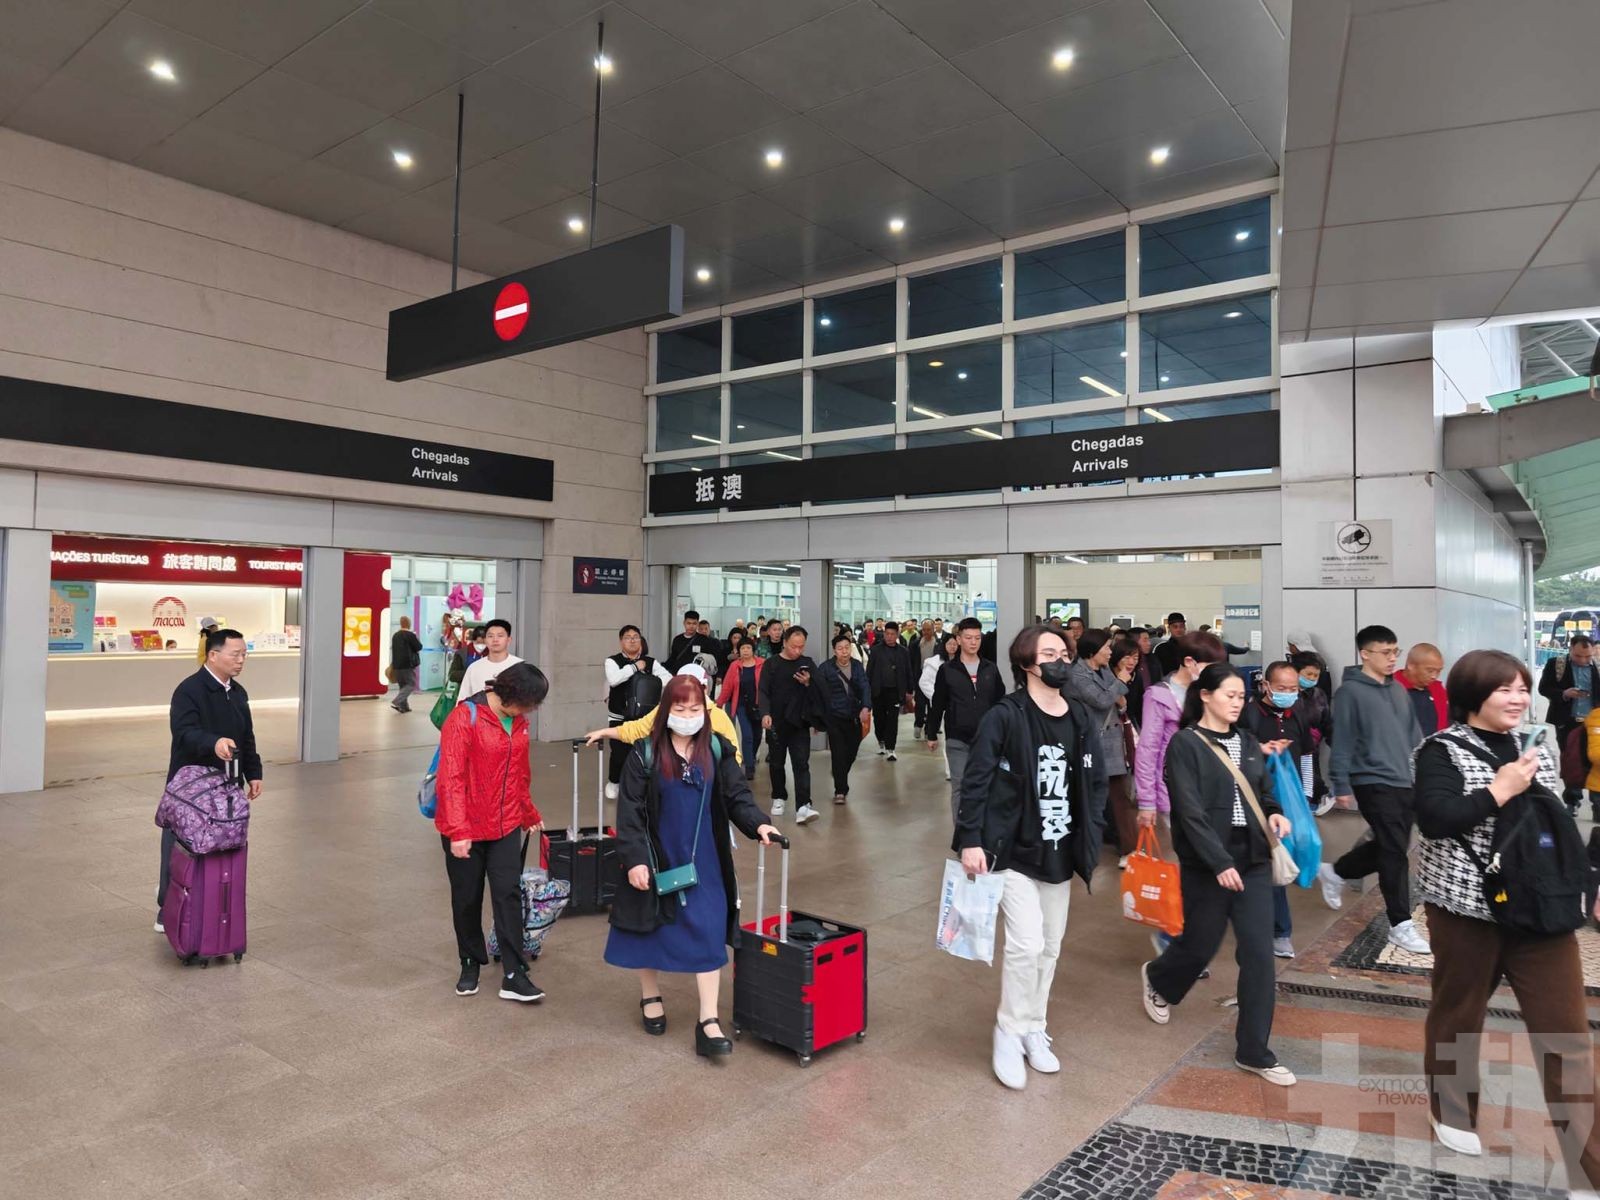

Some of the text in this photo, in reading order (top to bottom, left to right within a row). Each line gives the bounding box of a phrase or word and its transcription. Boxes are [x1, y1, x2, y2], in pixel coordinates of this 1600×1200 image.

[1071, 434, 1144, 452] Chegadas
[411, 447, 470, 466] Chegadas
[1072, 456, 1129, 473] Arrivals
[411, 466, 459, 482] Arrivals
[695, 473, 742, 502] 抵澳
[92, 552, 150, 565] TURÍSTICAS
[248, 560, 284, 570] TOURIST
[152, 616, 186, 627] macau
